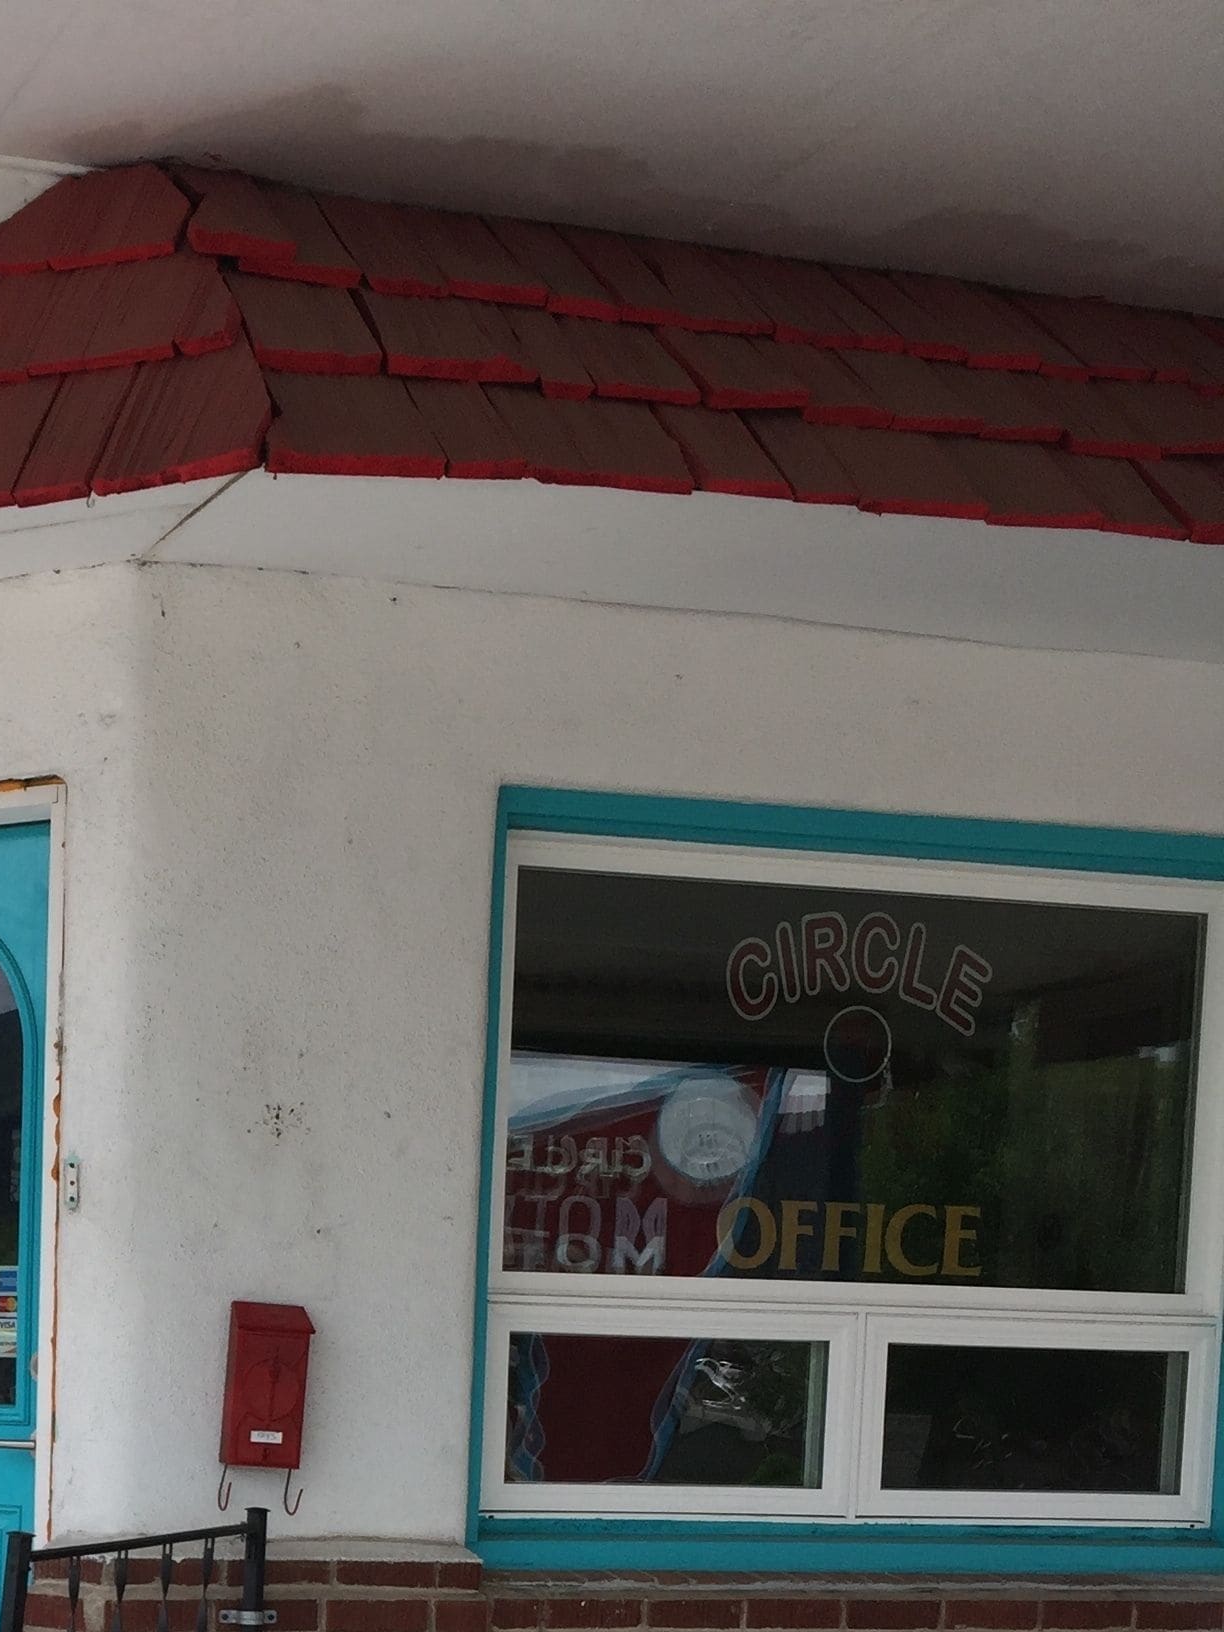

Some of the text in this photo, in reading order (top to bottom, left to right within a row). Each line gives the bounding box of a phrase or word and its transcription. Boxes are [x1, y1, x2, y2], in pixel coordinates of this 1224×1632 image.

[727, 912, 993, 1036] CIRCLE
[716, 1197, 982, 1277] OFFICE
[0, 1321, 15, 1329] VISA
